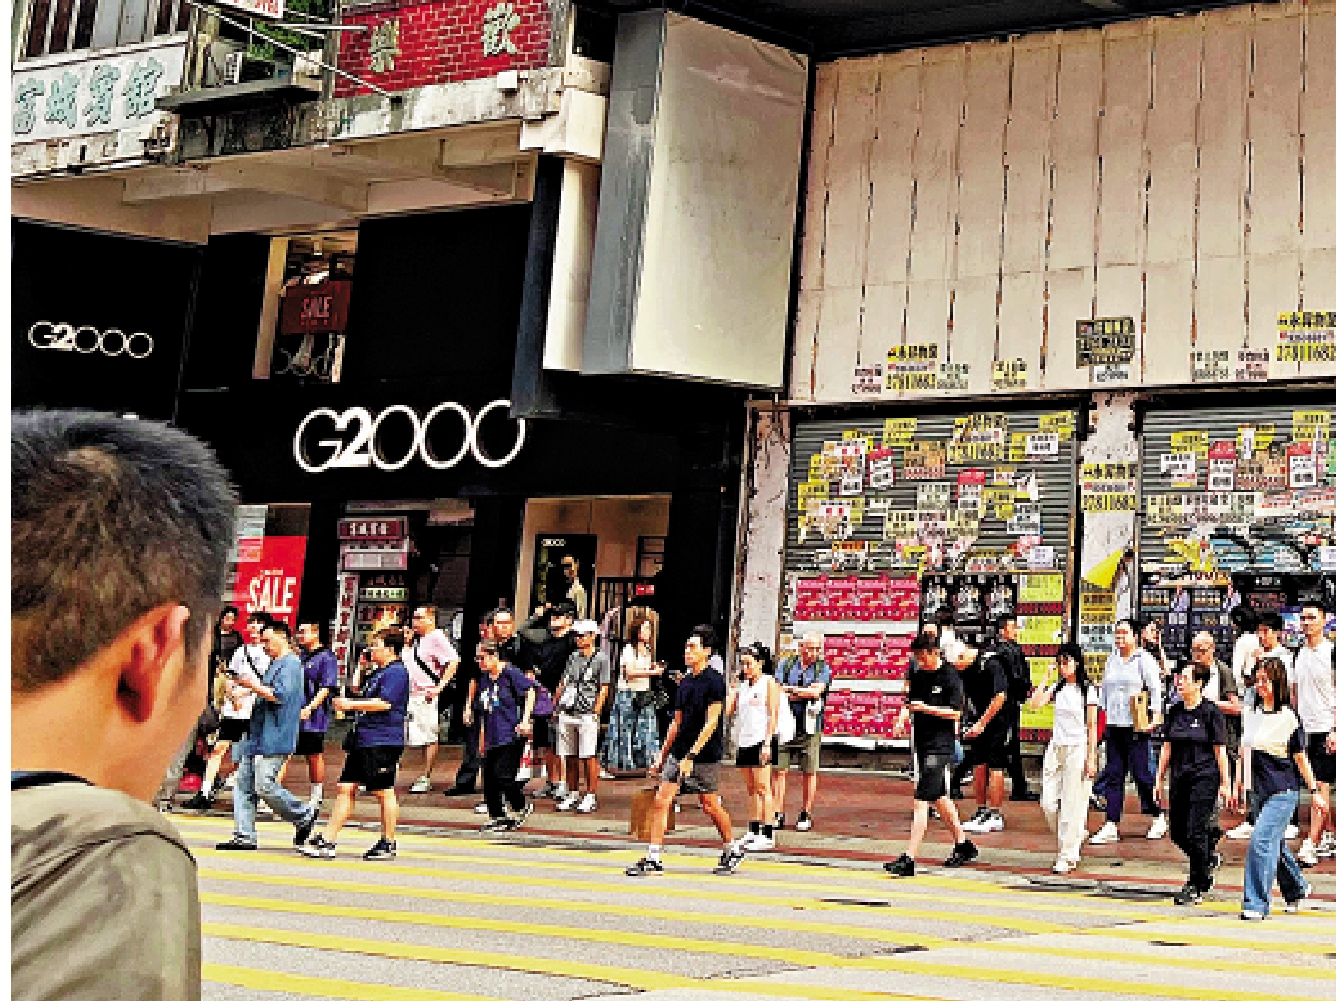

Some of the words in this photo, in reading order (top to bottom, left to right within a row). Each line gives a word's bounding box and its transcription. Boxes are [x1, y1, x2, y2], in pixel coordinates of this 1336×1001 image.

[28, 320, 154, 359] G2000
[293, 399, 526, 474] G2000
[247, 576, 297, 614] SALE
